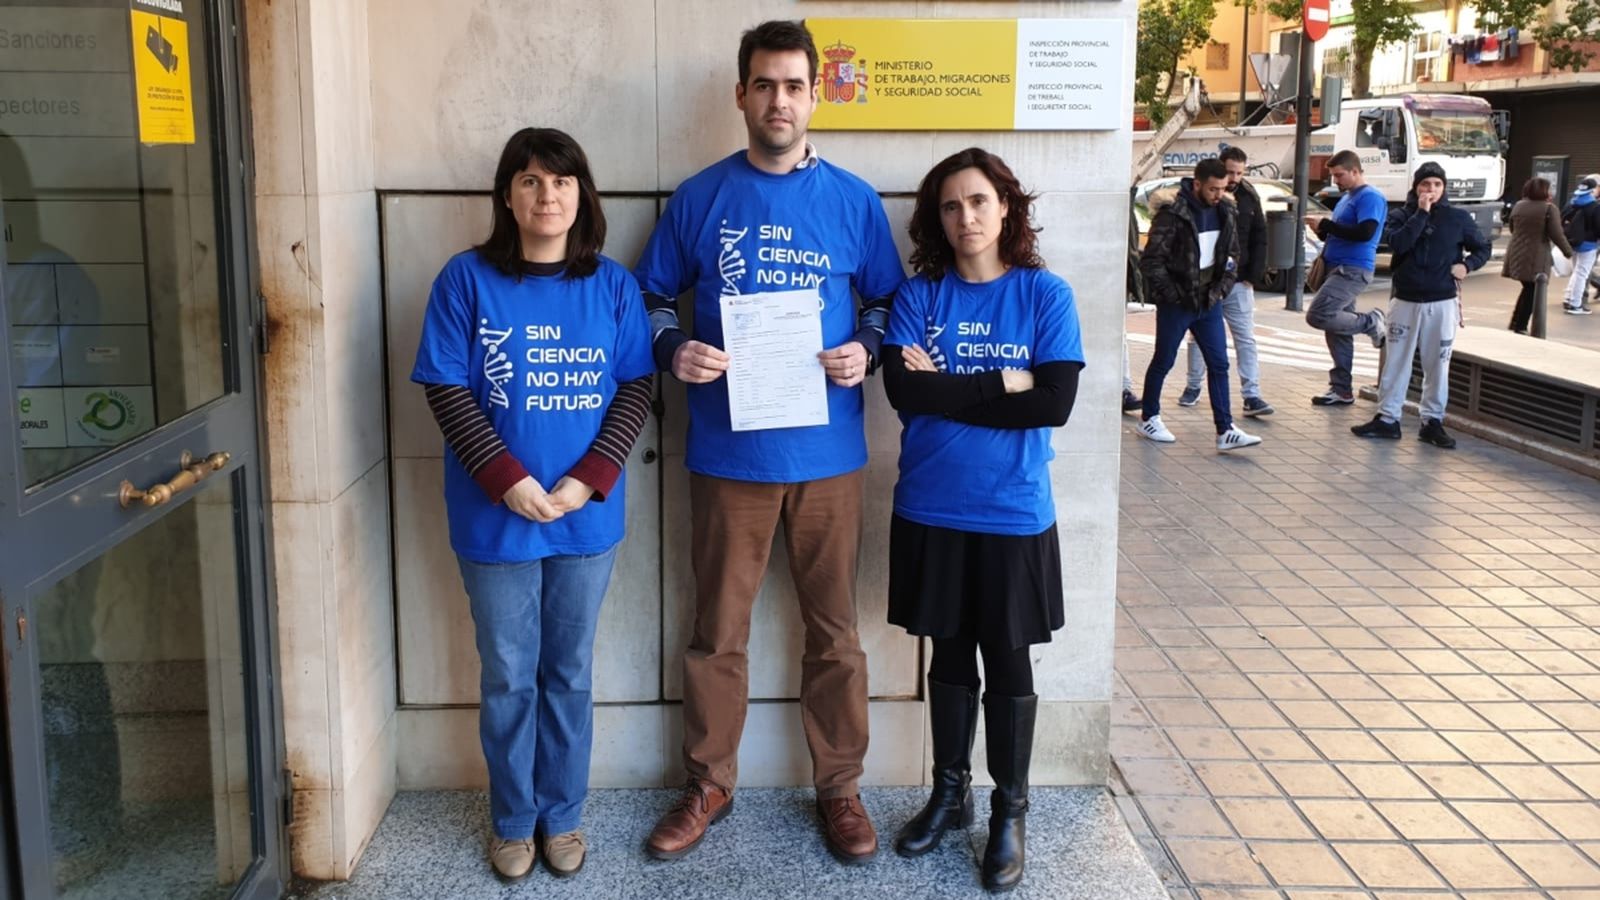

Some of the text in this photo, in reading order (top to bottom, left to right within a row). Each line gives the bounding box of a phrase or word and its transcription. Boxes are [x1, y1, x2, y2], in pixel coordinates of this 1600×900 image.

[0, 29, 96, 49] Sanciones
[875, 61, 933, 70] MINISTERIO
[875, 74, 1011, 85] DE TRABAJO, MIGRACIONES
[874, 88, 982, 96] Y SEGURIDAD SOCIAL
[1453, 181, 1474, 189] MAN
[759, 225, 792, 241] SIN
[758, 247, 831, 270] CIENCIA
[757, 269, 826, 289] NO HAY
[525, 325, 561, 340] SIN
[957, 322, 991, 336] SIN
[526, 347, 606, 363] CIENCIA
[956, 343, 1030, 359] CIENCIA
[526, 371, 602, 387] NO HAY
[526, 394, 602, 411] FUTURO
